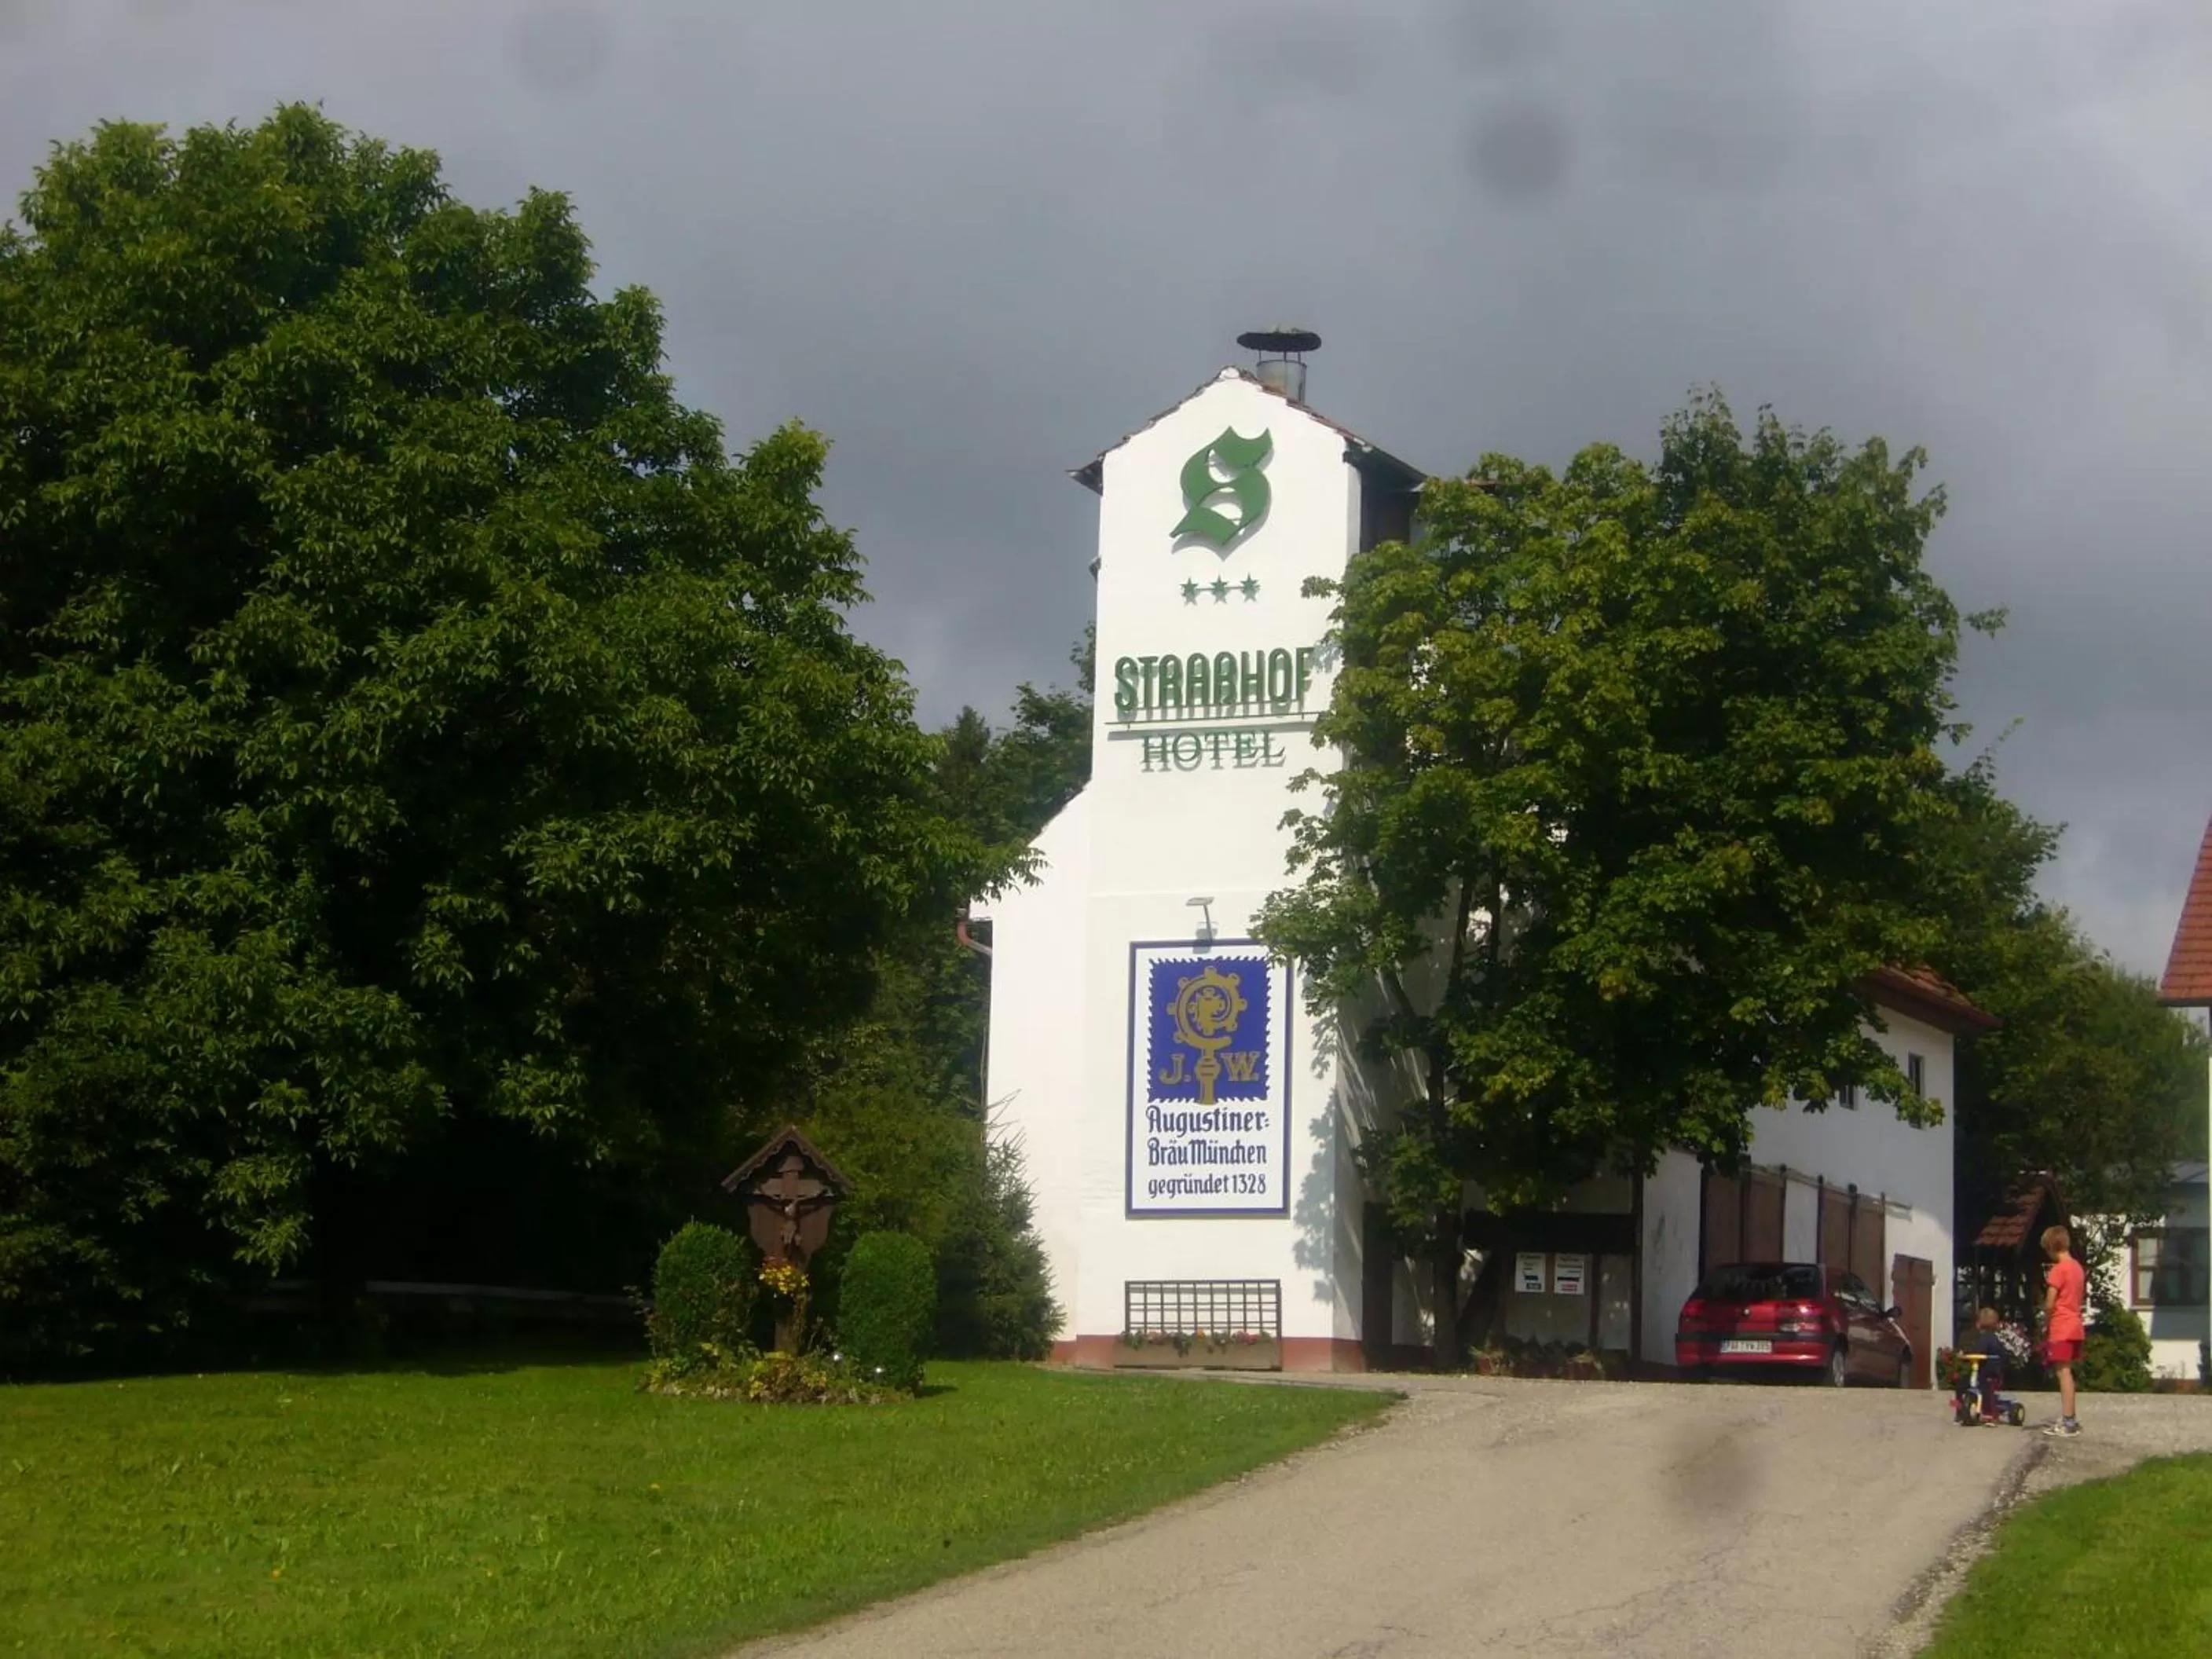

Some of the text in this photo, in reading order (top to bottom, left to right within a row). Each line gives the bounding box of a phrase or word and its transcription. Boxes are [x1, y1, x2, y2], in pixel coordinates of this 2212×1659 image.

[1141, 729, 1285, 764] HOTEL
[1148, 1173, 1266, 1199] gegründet 1328
